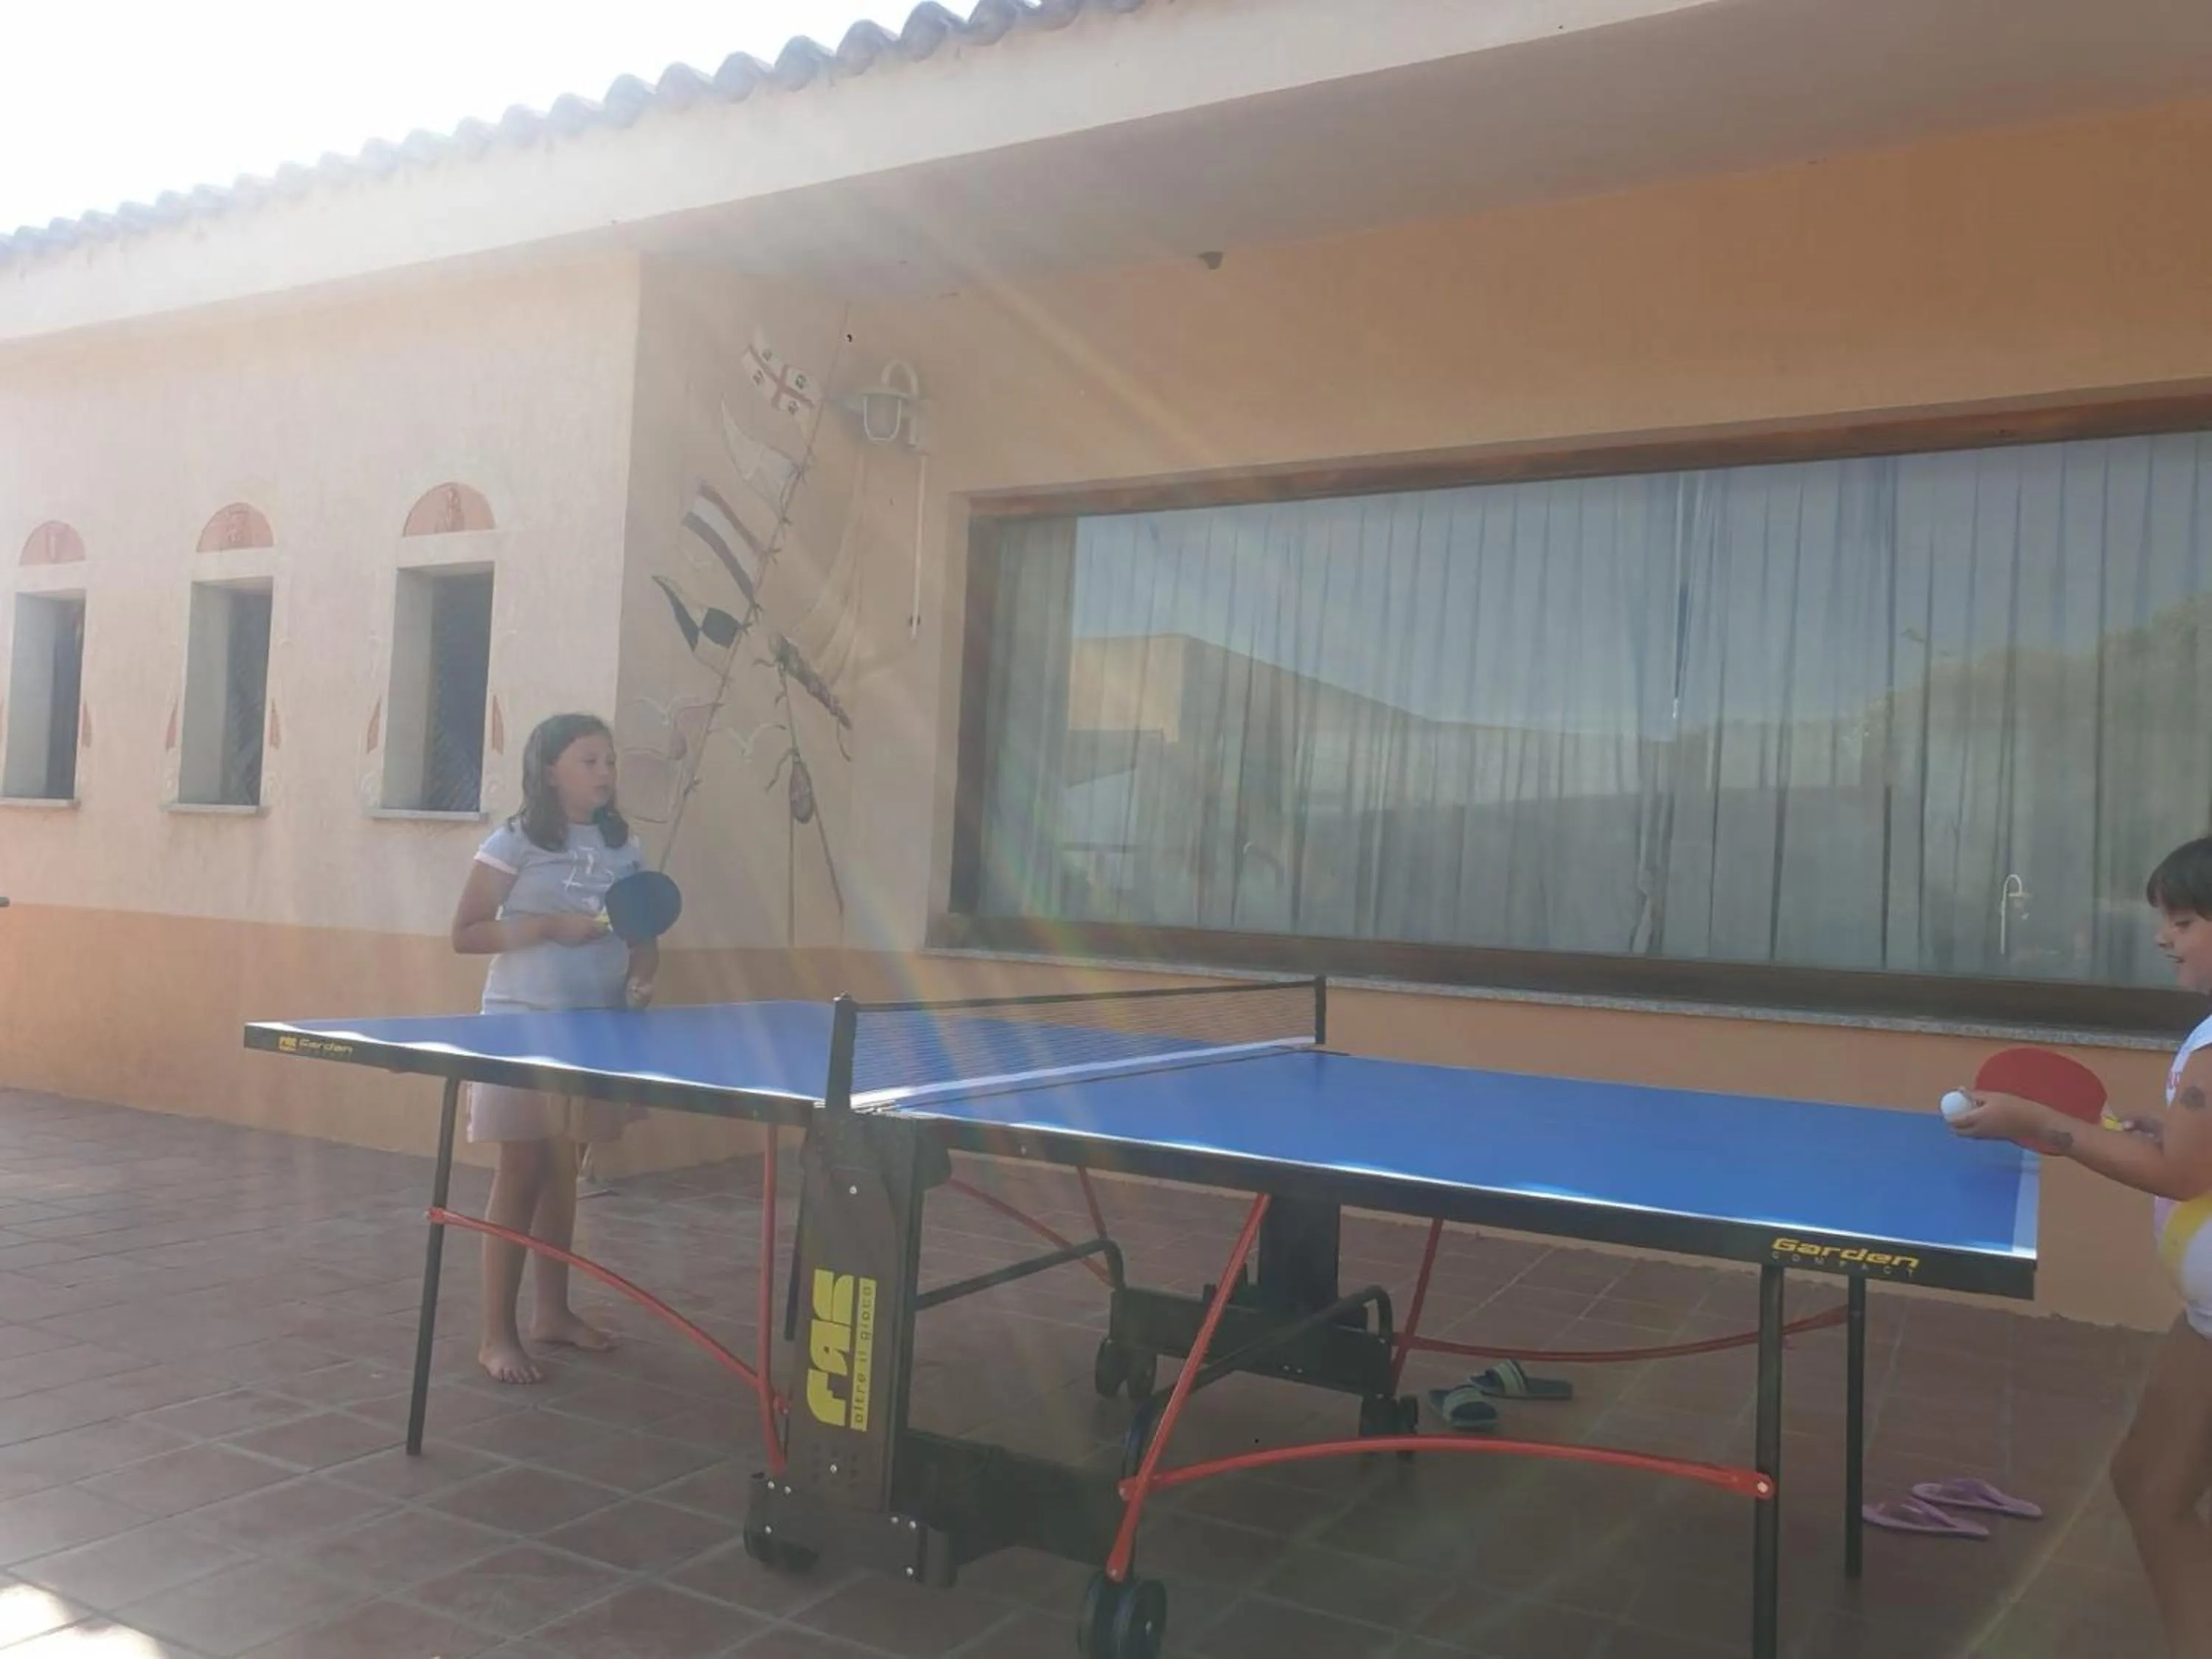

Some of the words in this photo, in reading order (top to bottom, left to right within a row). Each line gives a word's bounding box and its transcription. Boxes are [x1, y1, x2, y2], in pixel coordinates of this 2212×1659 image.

[1772, 1238, 1920, 1268] Garden
[1772, 1250, 1914, 1278] COMPACT
[807, 1268, 855, 1427] FAS
[853, 1373, 866, 1423] oltre
[860, 1286, 872, 1340] gioco
